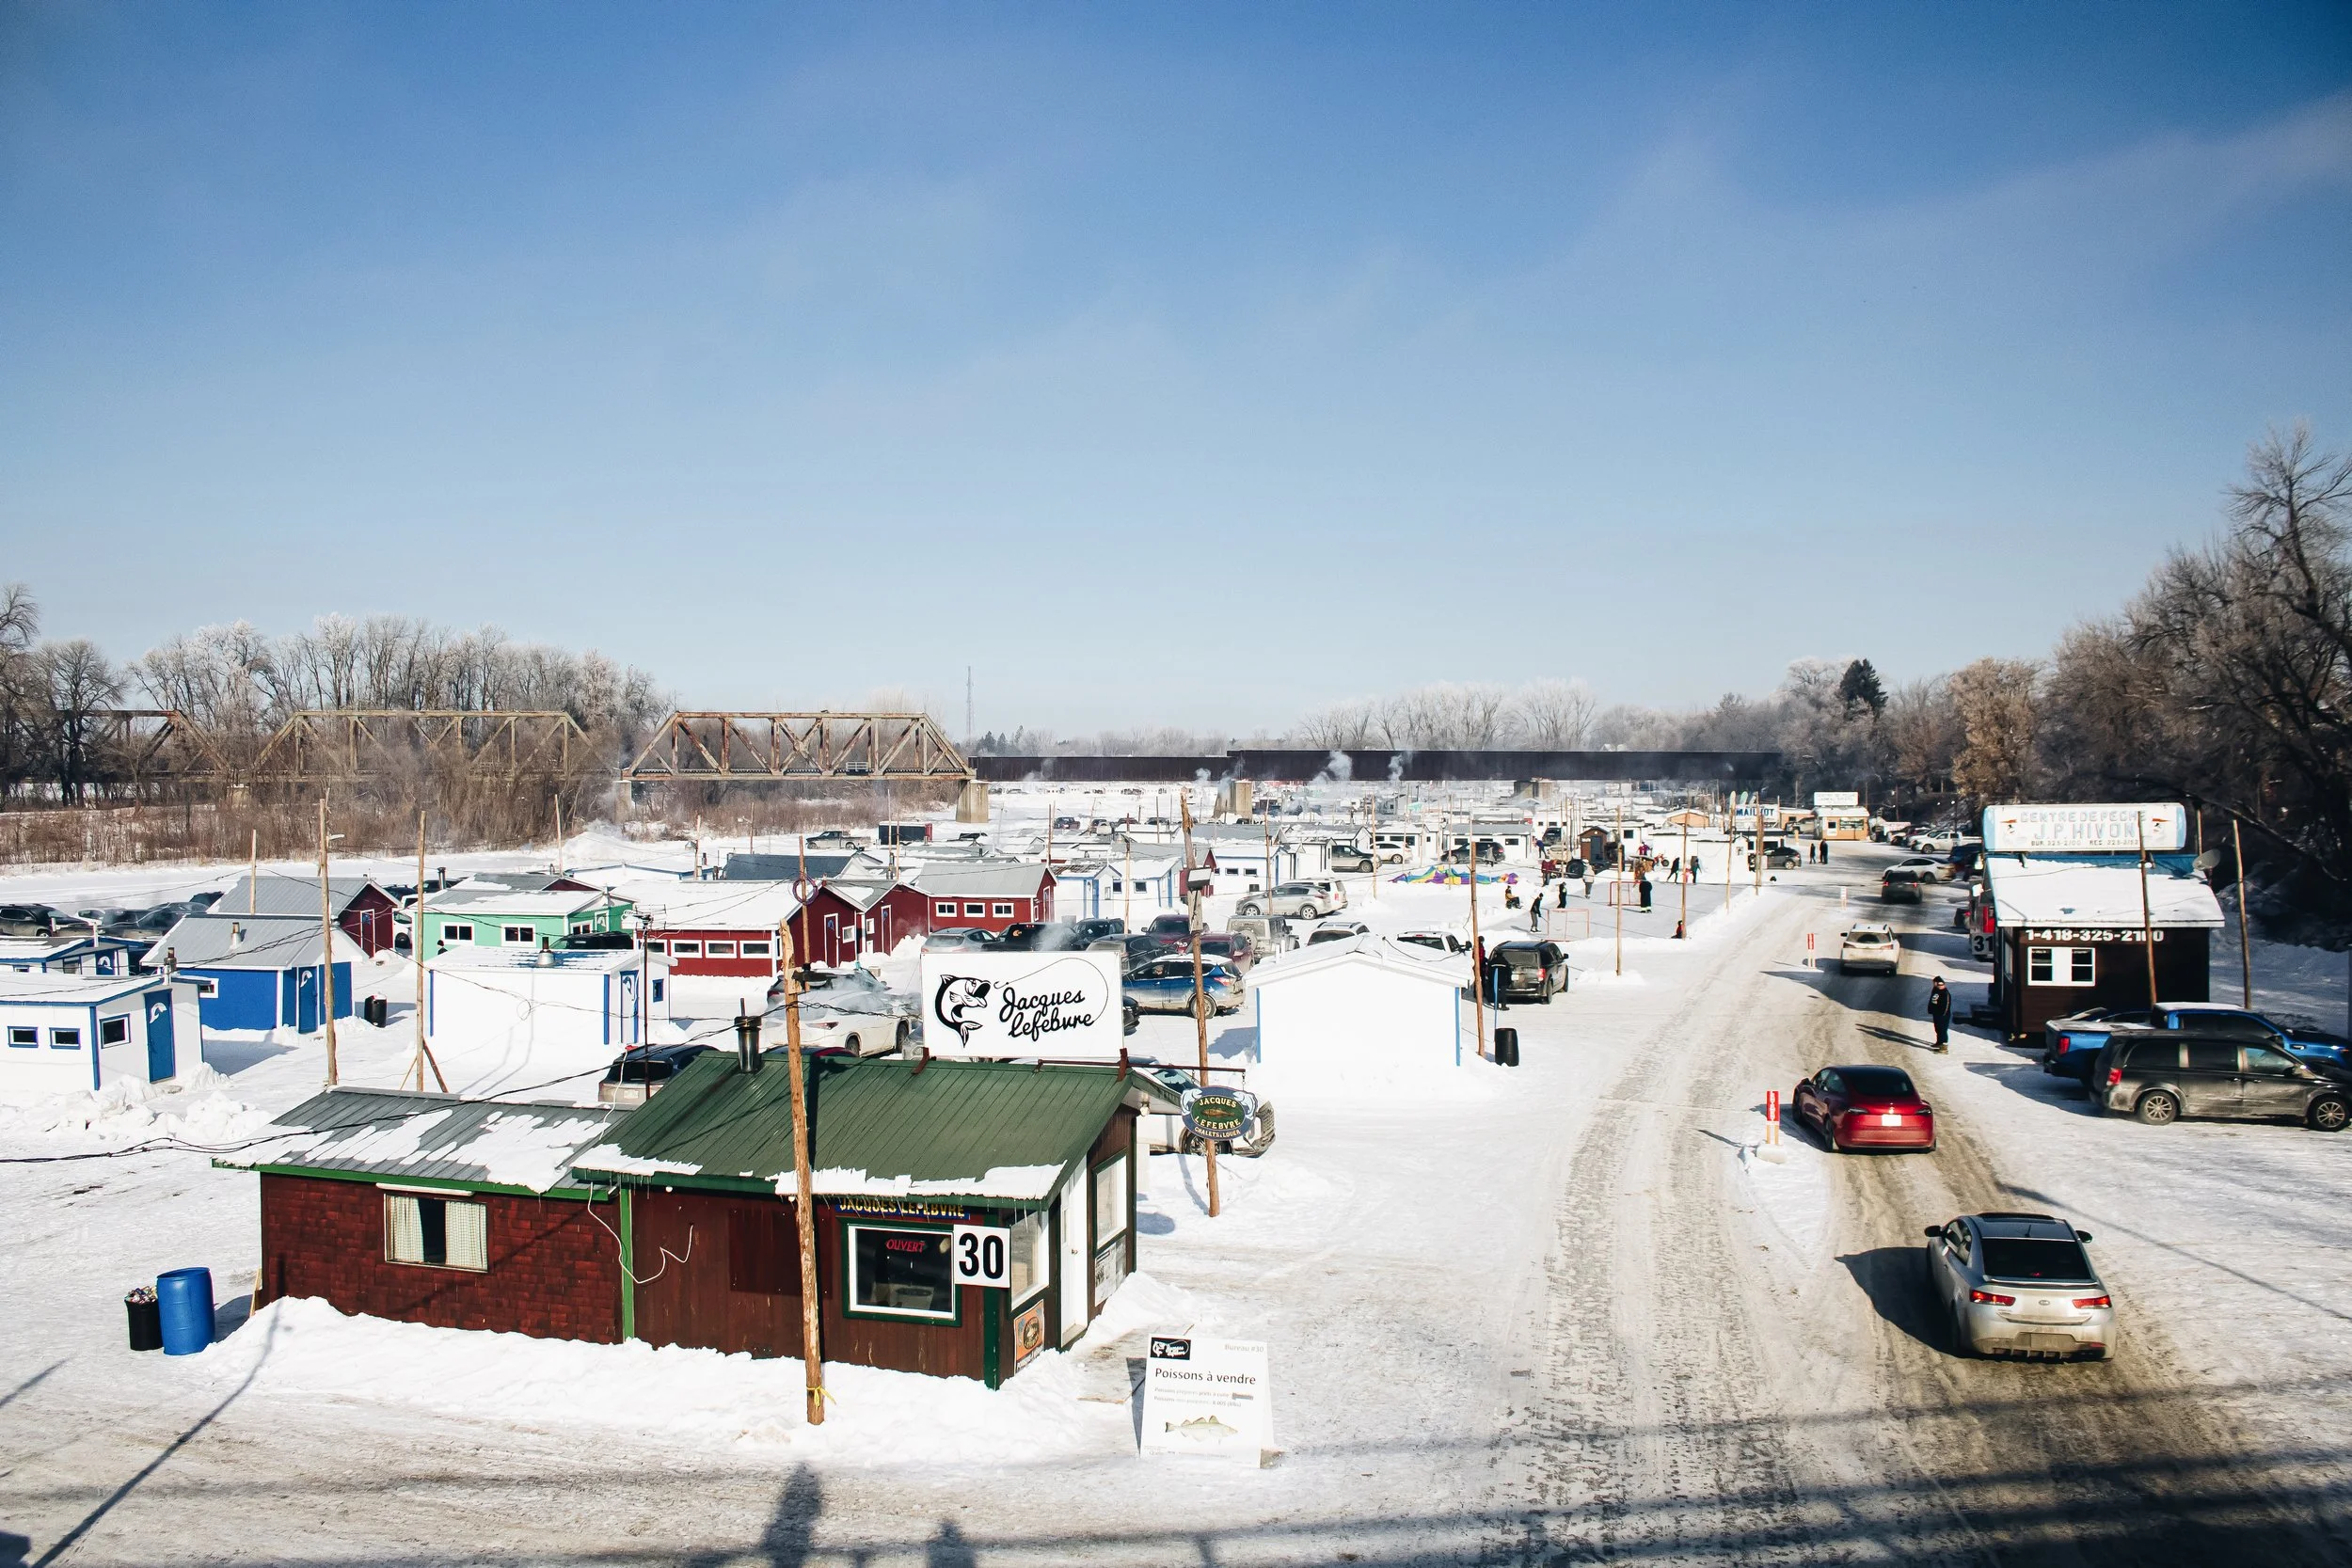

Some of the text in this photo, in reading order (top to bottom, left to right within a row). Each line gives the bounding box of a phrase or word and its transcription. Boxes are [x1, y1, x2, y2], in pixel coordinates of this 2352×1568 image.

[2022, 812, 2076, 823] CENTRE
[2079, 811, 2097, 822] DE
[2072, 822, 2136, 839] HIVON
[1974, 935, 1994, 952] 31
[999, 987, 1085, 1022] Jacques
[1200, 1097, 1237, 1108] JACQUES
[1194, 1116, 1241, 1130] LEFEBVRE
[1194, 1126, 1220, 1138] CHALETS
[1222, 1129, 1241, 1138] LOUER
[839, 1198, 897, 1213] JACQUES
[885, 1238, 926, 1253] OUVERT
[958, 1232, 1005, 1280] 30
[1224, 1343, 1249, 1352] Bureau
[1154, 1367, 1256, 1386] Poissons à vendre
